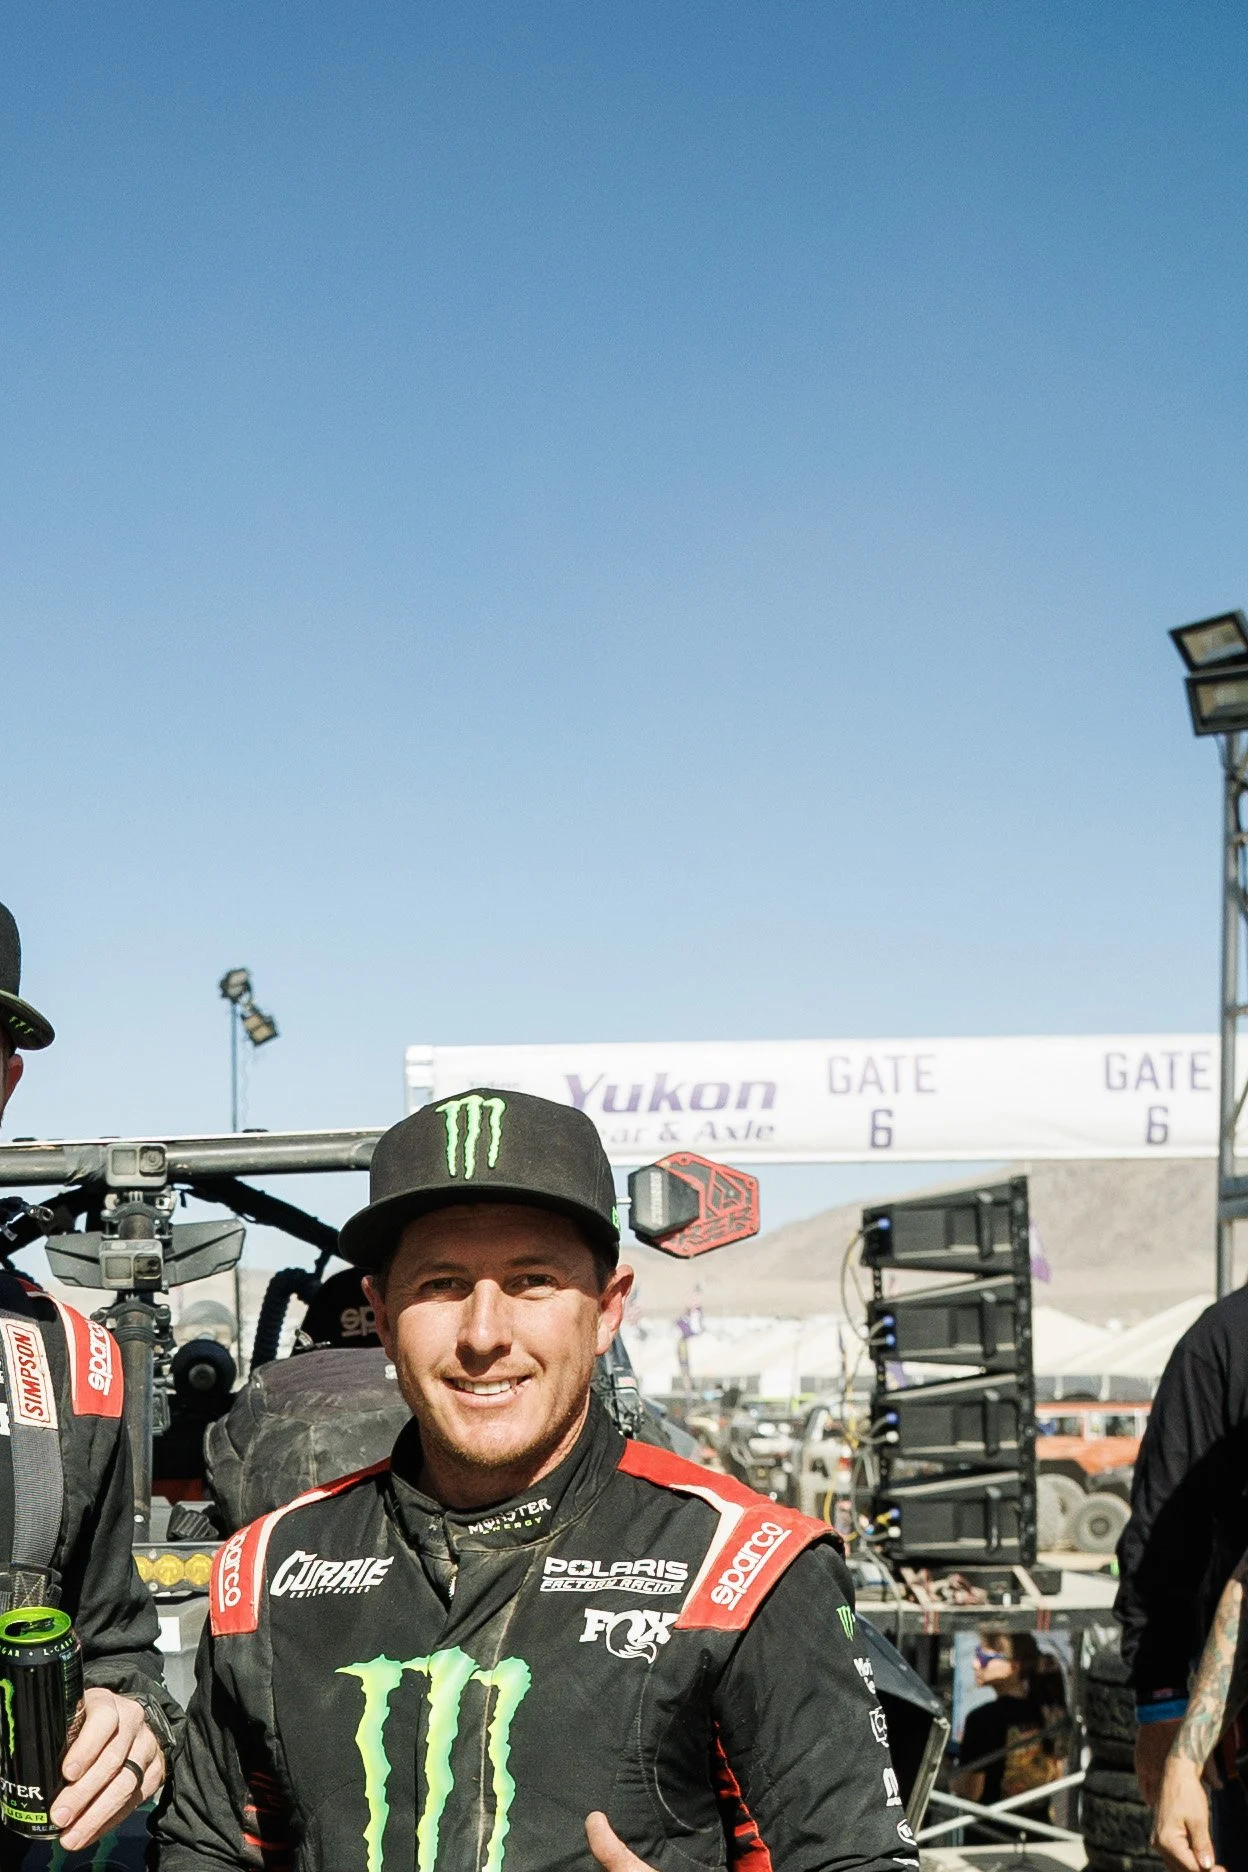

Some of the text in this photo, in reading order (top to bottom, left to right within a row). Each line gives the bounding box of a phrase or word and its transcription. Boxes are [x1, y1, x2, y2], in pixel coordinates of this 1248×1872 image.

[827, 1055, 937, 1095] GATE
[1104, 1051, 1212, 1092] GATE
[564, 1072, 777, 1113] Yukon
[659, 1121, 681, 1142] &
[695, 1120, 775, 1144] Axle
[870, 1108, 894, 1149] 6
[1144, 1105, 1170, 1146] 6
[12, 1331, 44, 1417] SIMPSON
[468, 1498, 552, 1534] MONSTER
[482, 1516, 542, 1534] ENERGY
[270, 1550, 395, 1597] CURRIE
[541, 1578, 684, 1594] FACTORY RACING
[543, 1557, 689, 1581] POLARIS
[710, 1521, 793, 1611] sparco
[289, 1585, 371, 1599] ENTERPRISES
[579, 1608, 682, 1664] FOX
[6, 1807, 44, 1821] UGAR
